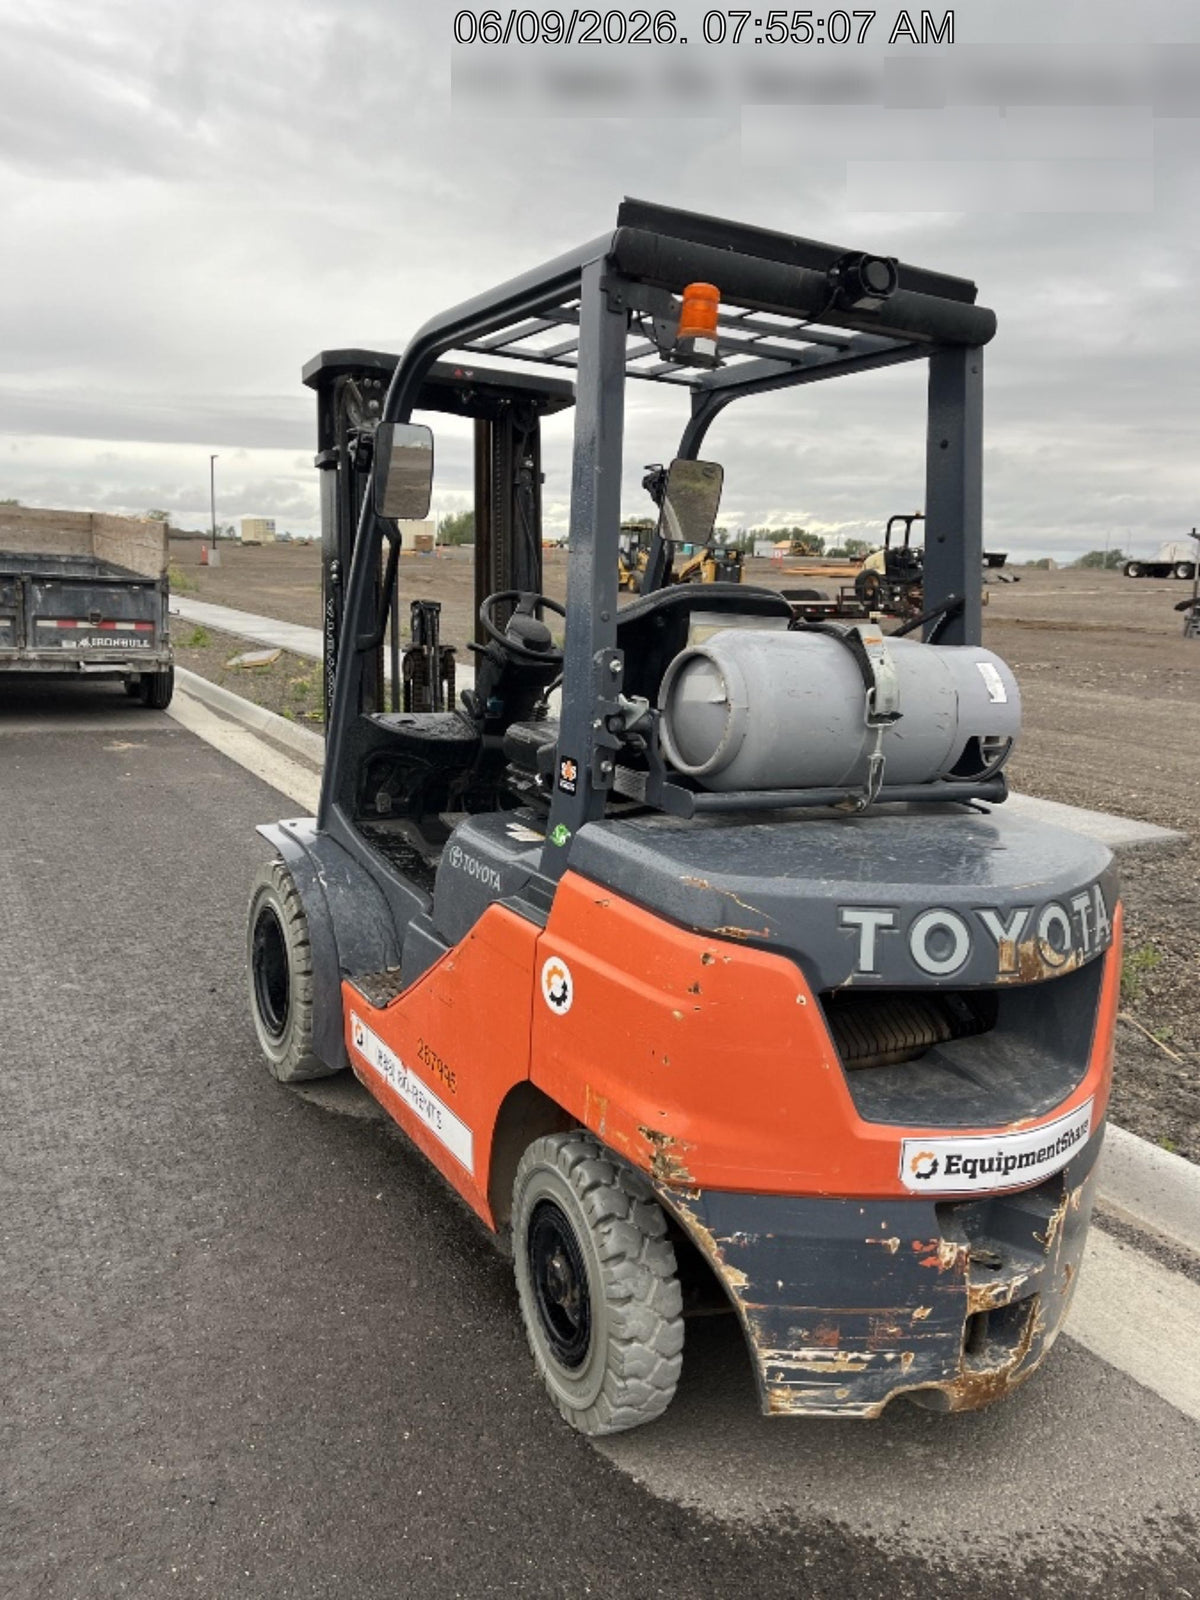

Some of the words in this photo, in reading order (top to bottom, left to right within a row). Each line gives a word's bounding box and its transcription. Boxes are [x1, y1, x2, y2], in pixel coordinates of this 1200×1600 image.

[463, 854, 501, 892] TOYOTA
[839, 884, 1110, 976] TOYOTA
[943, 1119, 1090, 1178] EquipmentShare
